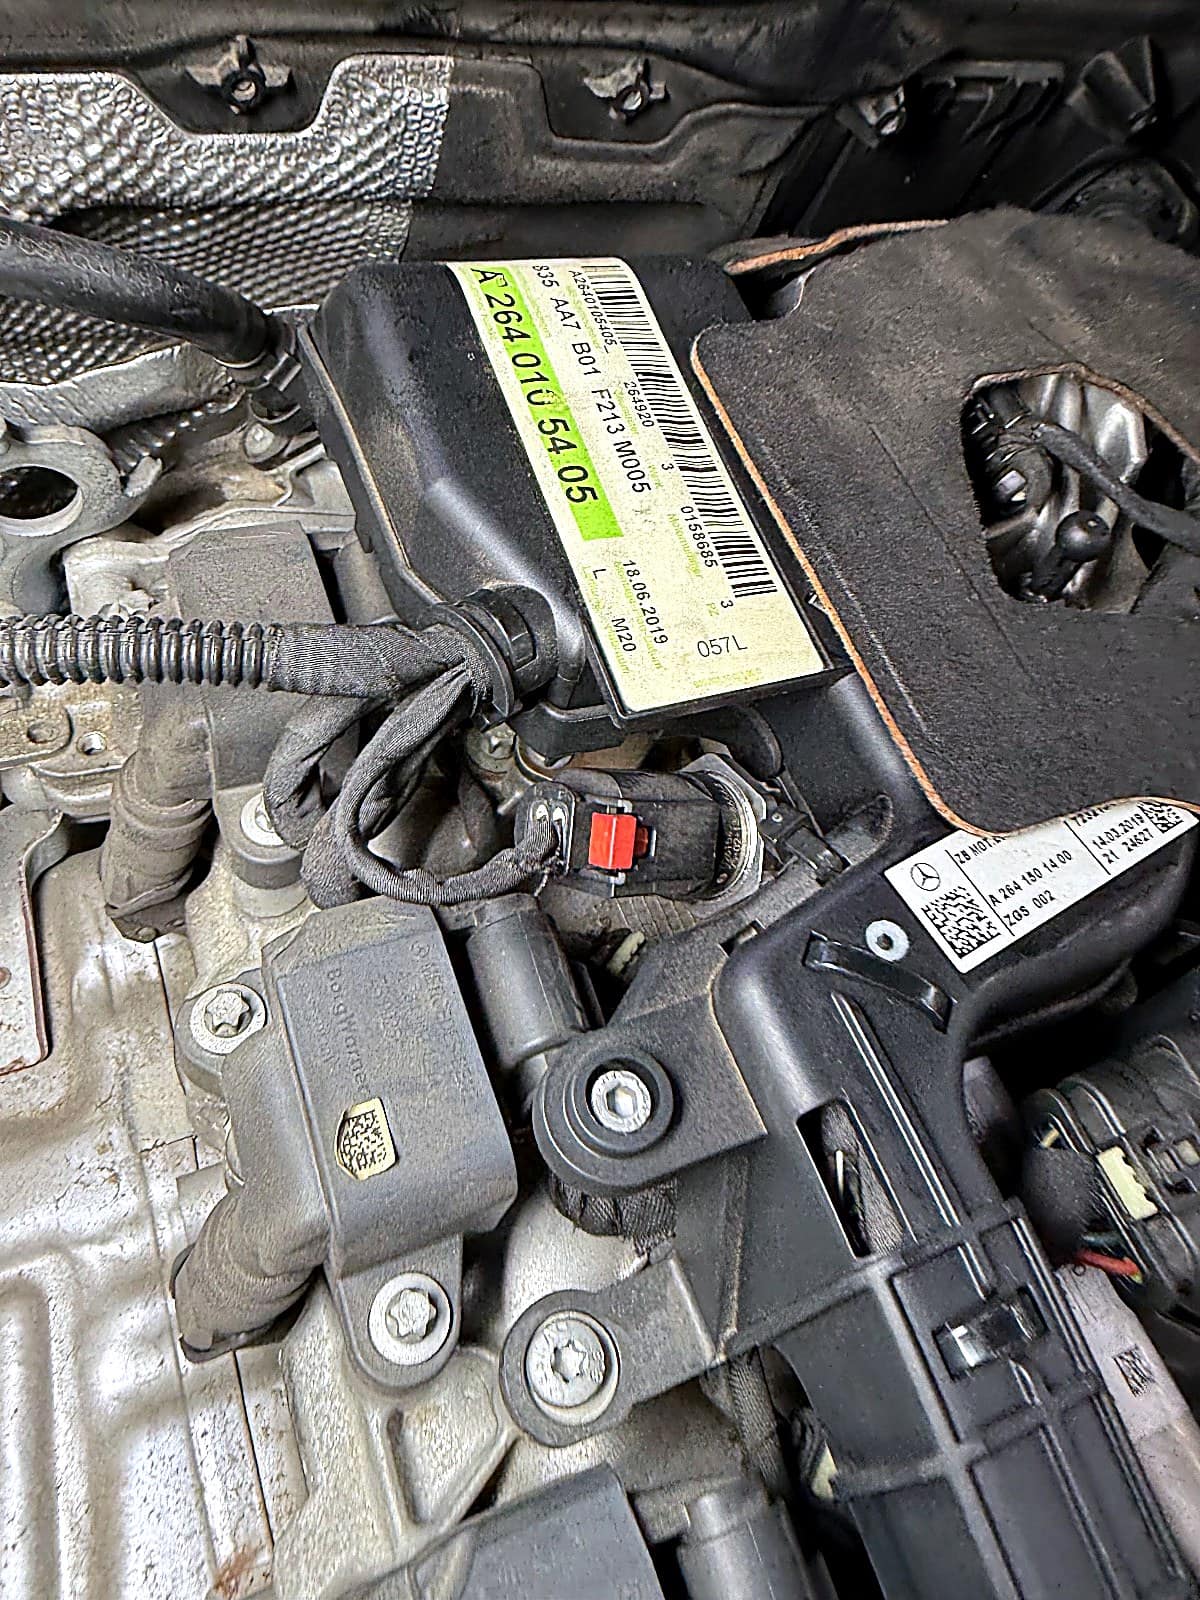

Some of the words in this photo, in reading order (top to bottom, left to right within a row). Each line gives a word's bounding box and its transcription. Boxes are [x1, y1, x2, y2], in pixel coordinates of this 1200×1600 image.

[470, 268, 508, 285] A
[483, 291, 530, 342] 264
[510, 350, 557, 406] 010
[549, 298, 581, 329] AA7
[570, 341, 601, 376] B01
[590, 388, 625, 435] F213
[613, 440, 651, 492] M005
[623, 380, 654, 427] 264920
[536, 418, 577, 454] 54
[556, 464, 598, 503] 05
[660, 462, 673, 471] 3
[680, 505, 718, 566] 0158685
[592, 568, 606, 580] L
[622, 560, 668, 645] 18.06.2019
[719, 599, 733, 608] 3
[611, 618, 636, 652] M20
[697, 635, 748, 658] 057L
[1102, 849, 1119, 863] 21
[989, 893, 1001, 906] A
[998, 880, 1022, 899] 264
[1042, 858, 1058, 872] 14
[1056, 849, 1072, 864] 00
[1032, 889, 1055, 908] 002
